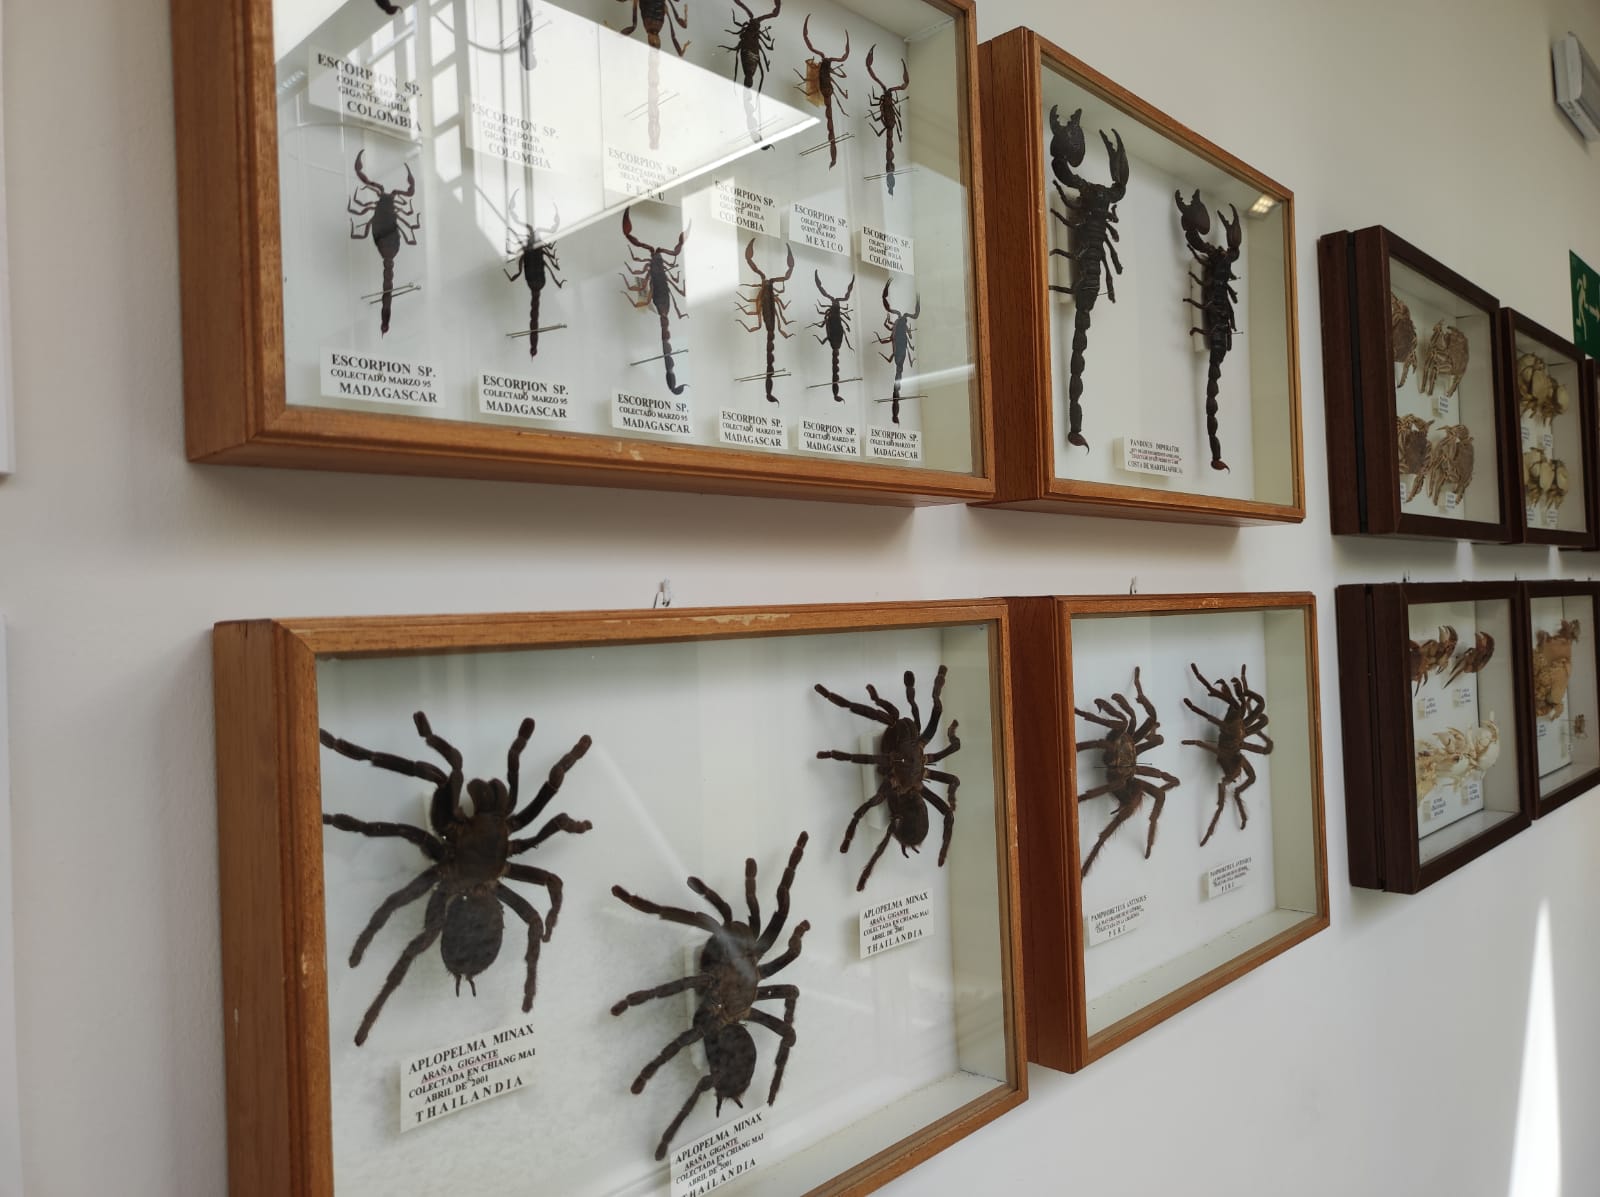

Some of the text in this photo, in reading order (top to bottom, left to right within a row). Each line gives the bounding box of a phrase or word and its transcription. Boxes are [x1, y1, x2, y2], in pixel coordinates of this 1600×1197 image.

[404, 81, 423, 98] SP.
[472, 103, 559, 139] ESCORPION SP.
[488, 143, 552, 169] COLOMBIA
[608, 147, 663, 171] ESCORPION
[715, 180, 776, 208] ESCORPION SP.
[753, 204, 761, 212] EN
[794, 204, 849, 229] ESCORPION SP.
[720, 211, 764, 232] COLOMBIA
[800, 216, 829, 231] COLECTADO
[805, 235, 844, 253] MEXICO
[863, 226, 911, 249] ESCORPION SP.
[869, 254, 904, 271] COLOMBIA
[331, 353, 437, 378] ESCORPION SP.
[330, 368, 432, 388] COLECTADO MARZO 95
[482, 374, 569, 396] ESCORPION SP.
[339, 381, 438, 403] MADAGASCAR
[483, 388, 529, 402] COLECTADO
[531, 394, 559, 405] MARZO
[485, 399, 567, 418] MADAGASCAR
[617, 393, 689, 413] ESCORPION SP.
[618, 406, 688, 422] COLECTADO MARZO 95
[722, 410, 783, 428] ESCORPION SP.
[622, 416, 691, 434] MADAGASCAR
[722, 422, 754, 433] COLECTADO
[756, 427, 776, 436] MARZO
[803, 420, 857, 436] ESCORPION SP.
[871, 428, 919, 442] ESCORPION SP.
[724, 431, 782, 448] MADAGASCAR
[803, 431, 831, 441] COLECTADO
[831, 436, 850, 444] MARZO
[806, 440, 857, 455] MADAGASCAR
[873, 447, 919, 459] MADAGASCAR
[864, 891, 928, 919] APLOPELMA MINAX
[887, 908, 910, 920] GIGANTE
[863, 921, 892, 937] COLECTADA
[872, 931, 887, 941] ABRIL
[866, 929, 923, 955] THAILANDIA
[408, 1023, 535, 1075] APLOPELMA MINAX
[408, 1047, 536, 1099] COLECTADA EN CHIANG MAI
[421, 1048, 499, 1084] ARAÑA GIGANTE
[415, 1074, 523, 1123] THAILANDIA
[424, 1074, 489, 1105] ABRIL DE 2001
[676, 1112, 762, 1165] APLOPELMA MINAX
[709, 1136, 739, 1157] GIGANTE
[675, 1132, 764, 1185] COLECTADA EN CHIANG MAI
[708, 1166, 719, 1178] DE
